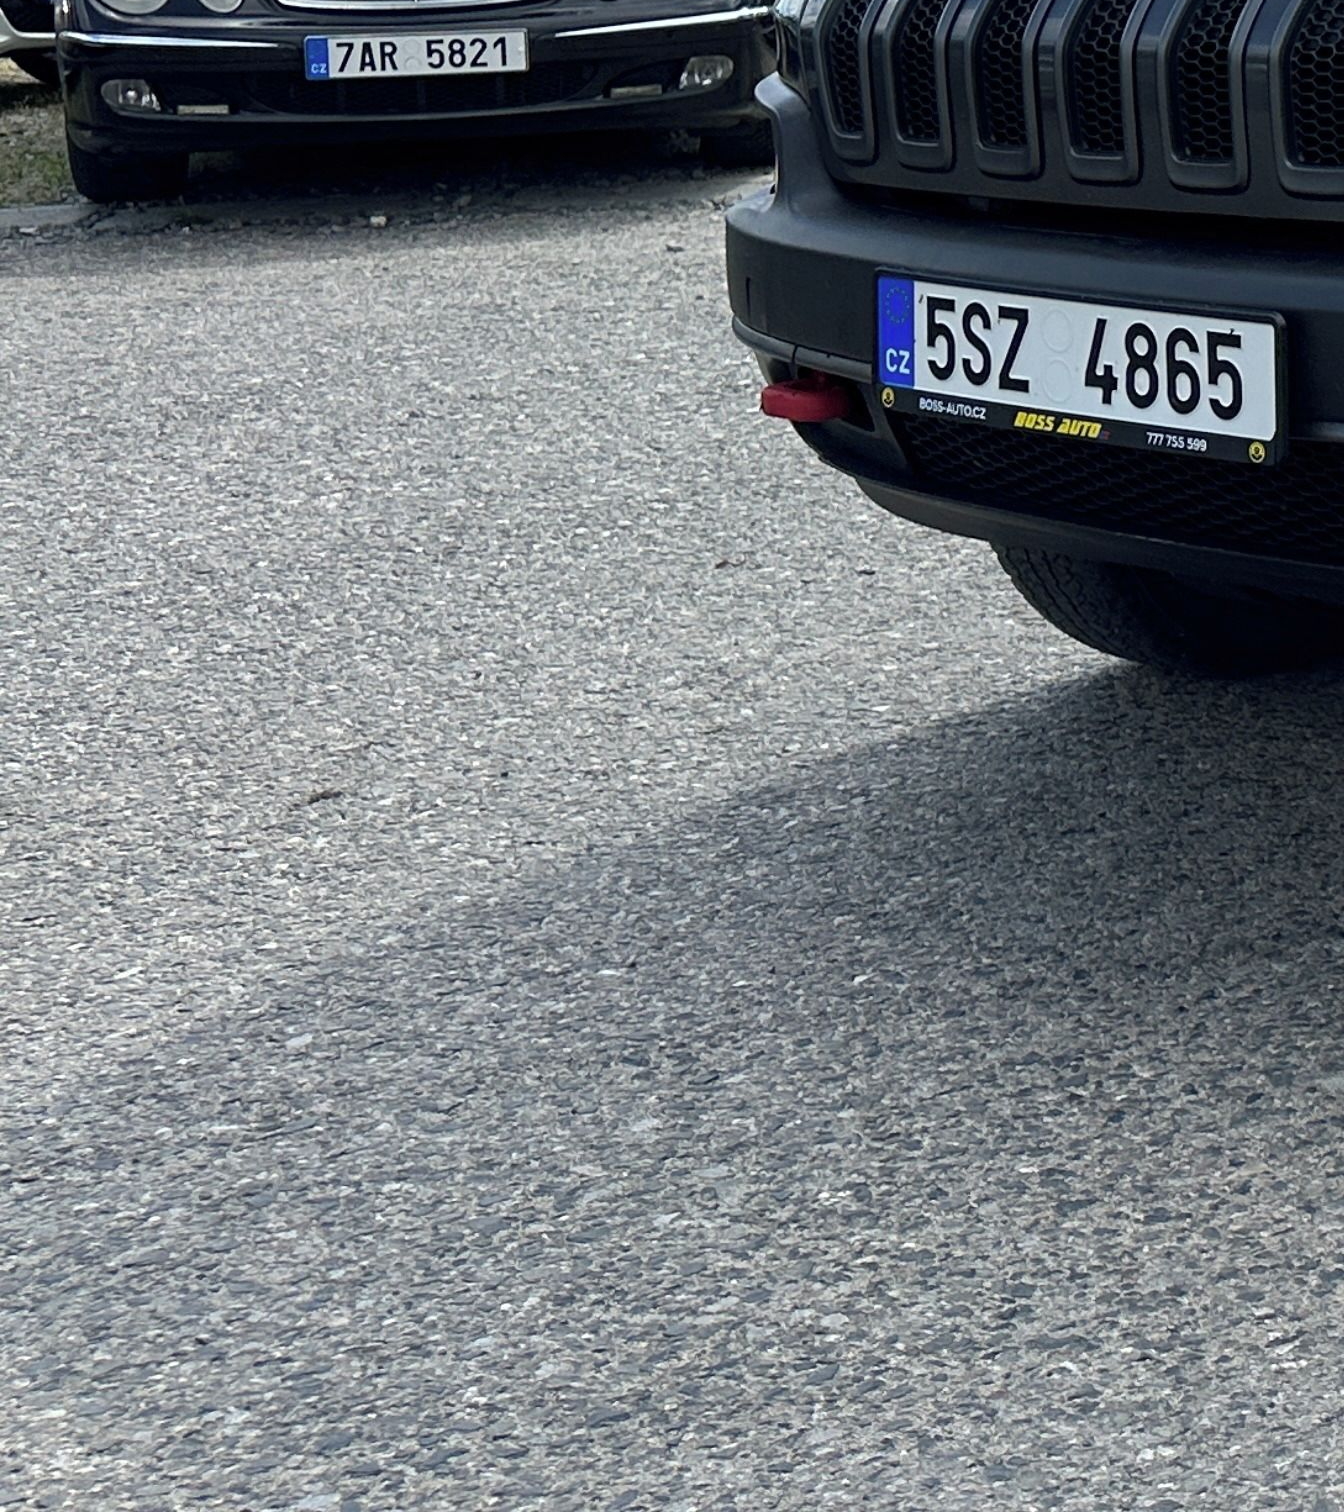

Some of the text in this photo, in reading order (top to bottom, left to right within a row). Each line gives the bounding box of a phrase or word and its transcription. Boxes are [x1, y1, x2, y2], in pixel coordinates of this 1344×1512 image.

[310, 62, 328, 74] CZ
[335, 36, 508, 73] 7AR 5821
[885, 346, 911, 375] CZ
[926, 295, 1243, 421] 5SZ 4865
[919, 397, 987, 420] BOSS-AUTO.CZ
[1013, 411, 1103, 439] BOSS AUTO
[1146, 431, 1208, 452] 777 755 599
